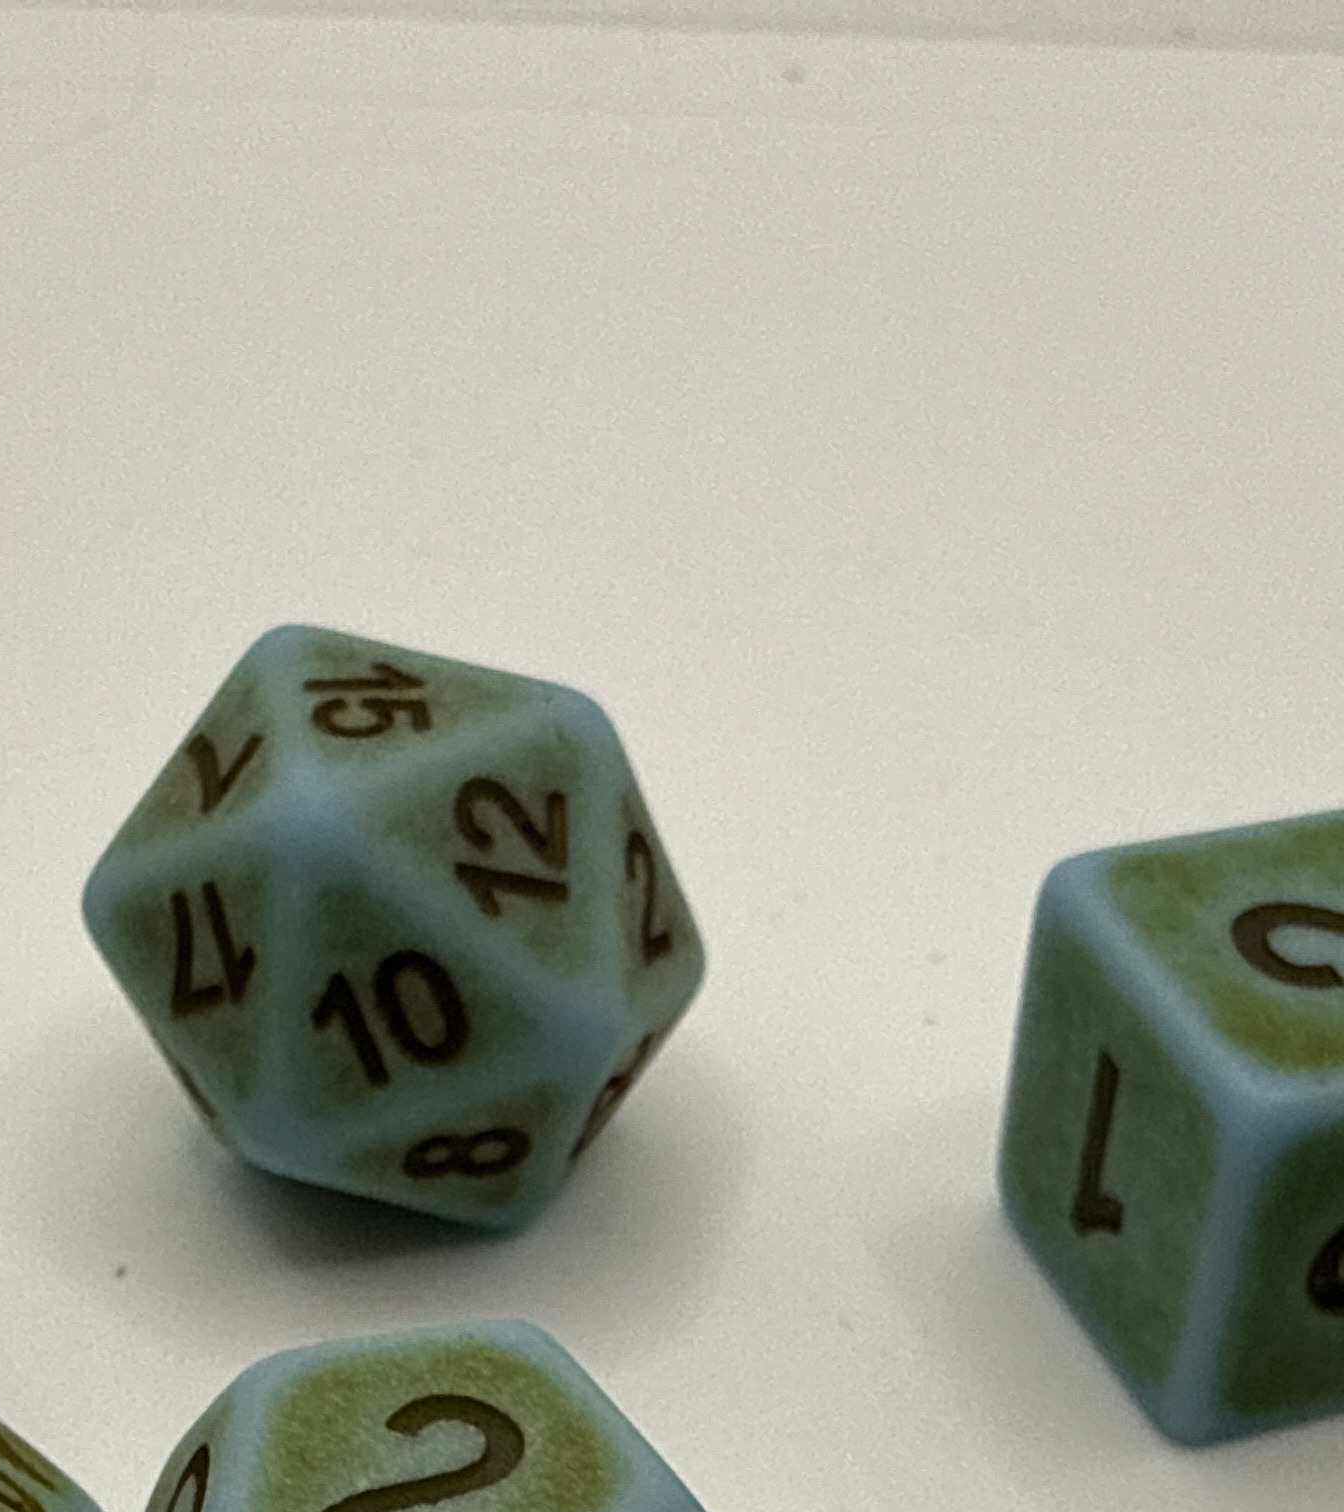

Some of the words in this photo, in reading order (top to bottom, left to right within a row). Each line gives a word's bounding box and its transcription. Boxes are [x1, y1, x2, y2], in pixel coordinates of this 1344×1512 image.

[302, 661, 433, 739] 15
[453, 775, 570, 918] 12
[624, 830, 673, 962] 2
[310, 949, 471, 1089] 10
[402, 1125, 532, 1181] 8
[1069, 1047, 1125, 1238] 1
